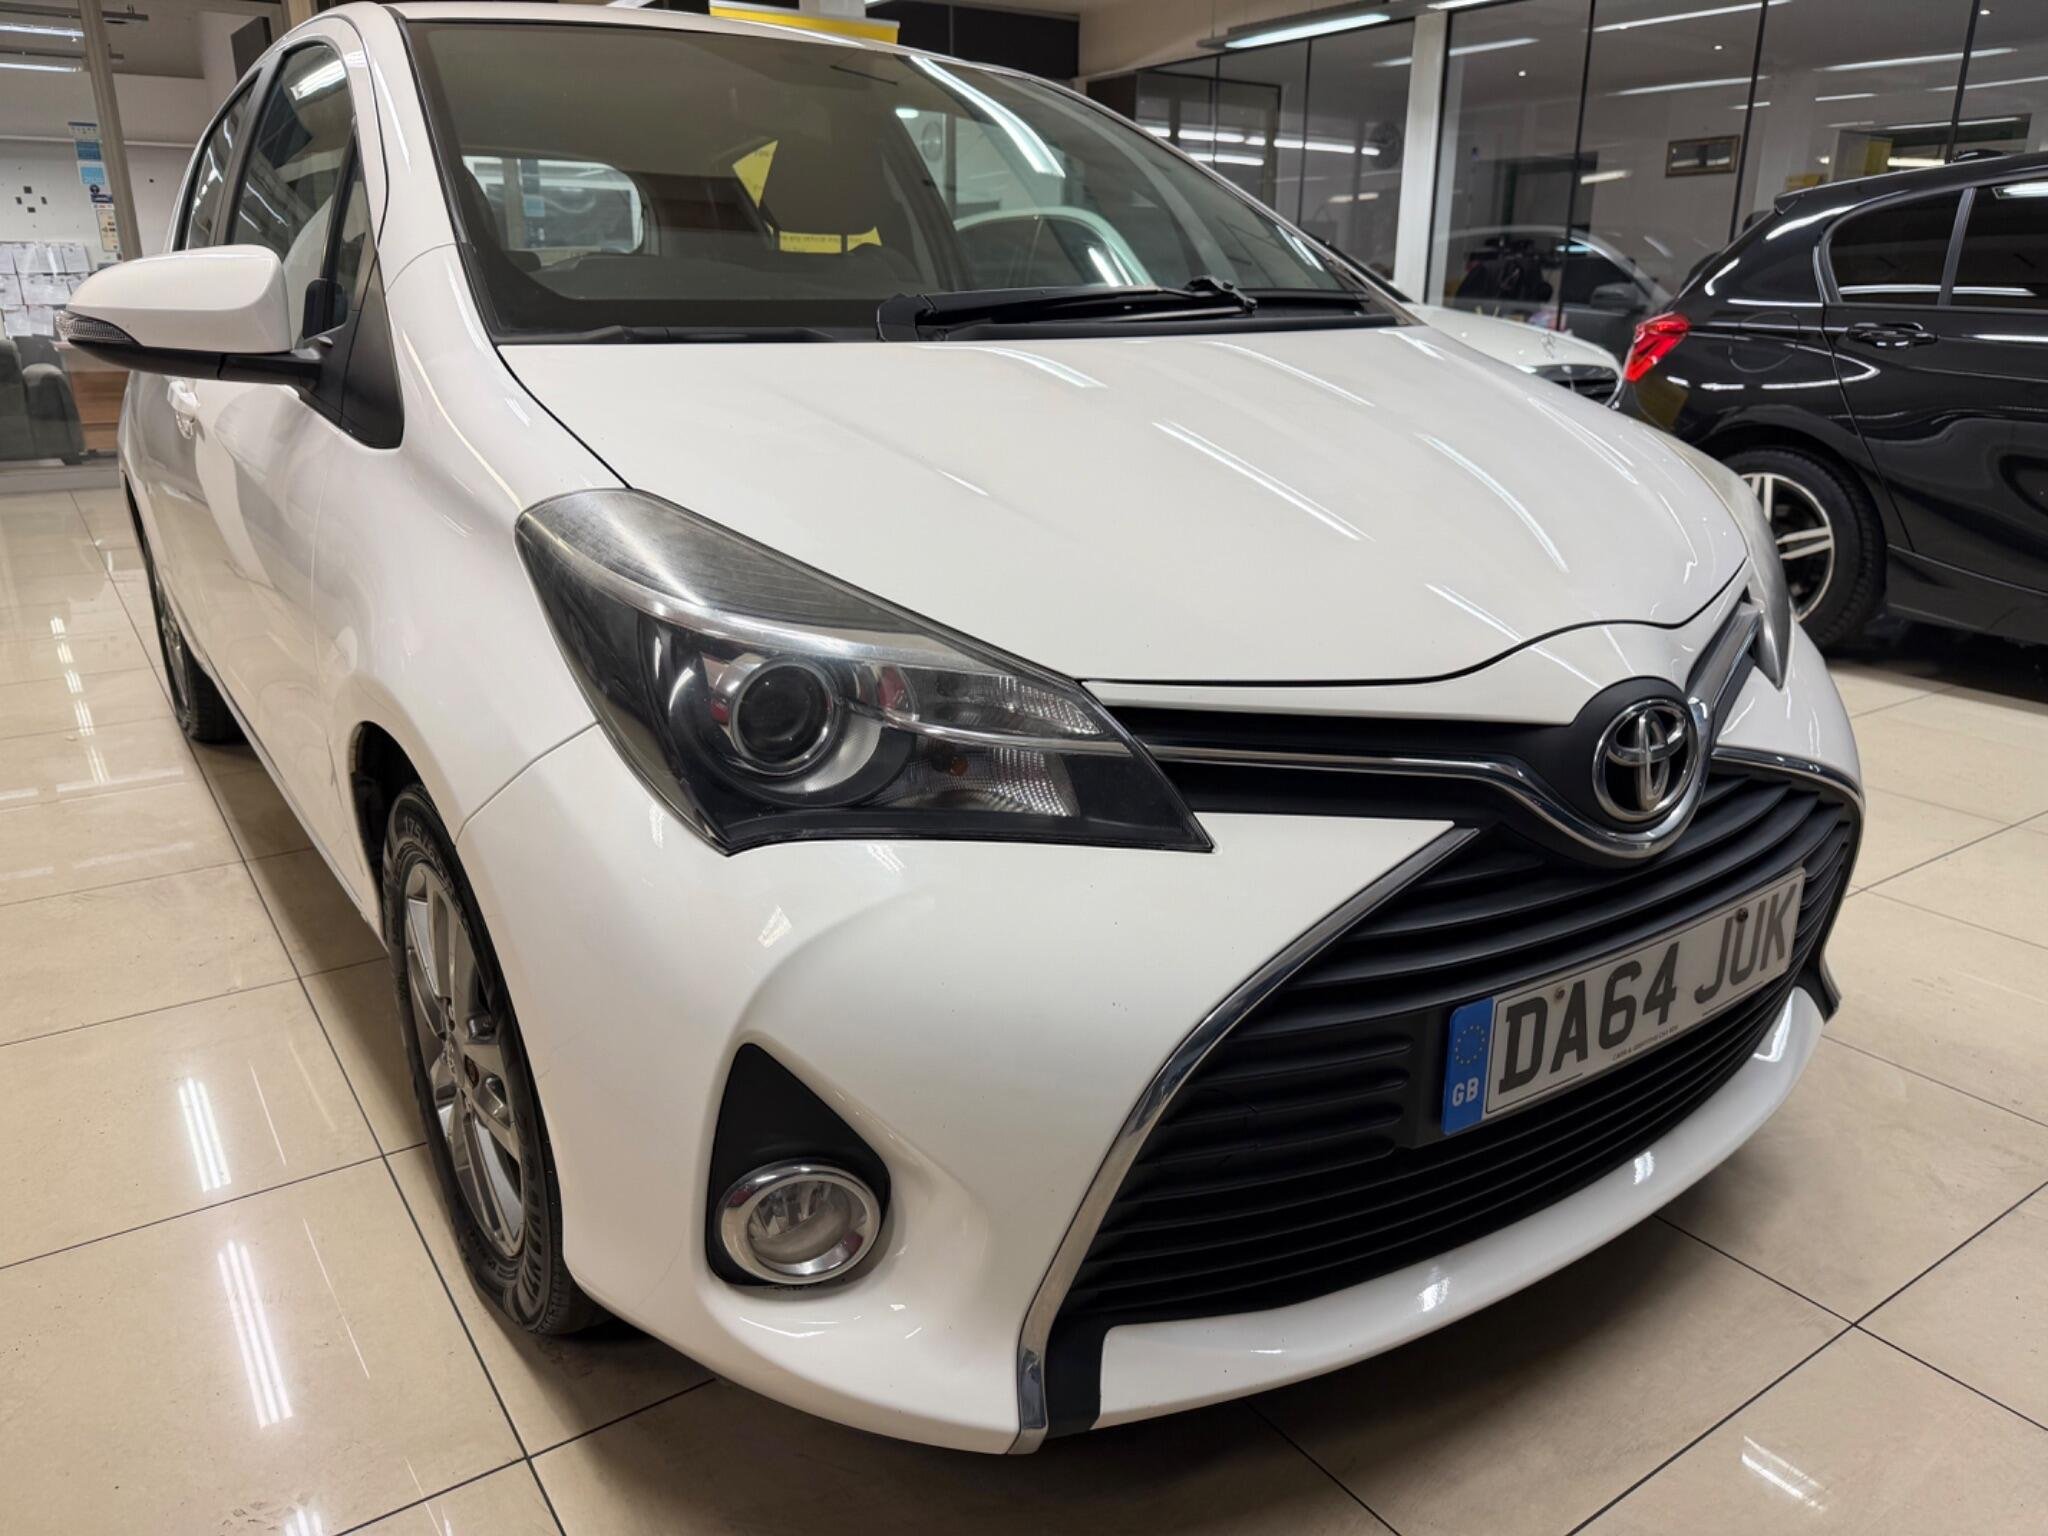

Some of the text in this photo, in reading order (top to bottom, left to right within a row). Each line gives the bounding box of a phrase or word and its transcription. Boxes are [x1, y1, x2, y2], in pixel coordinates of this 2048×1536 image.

[1499, 884, 1797, 1095] DA64 JUK
[1452, 1077, 1480, 1107] GB
